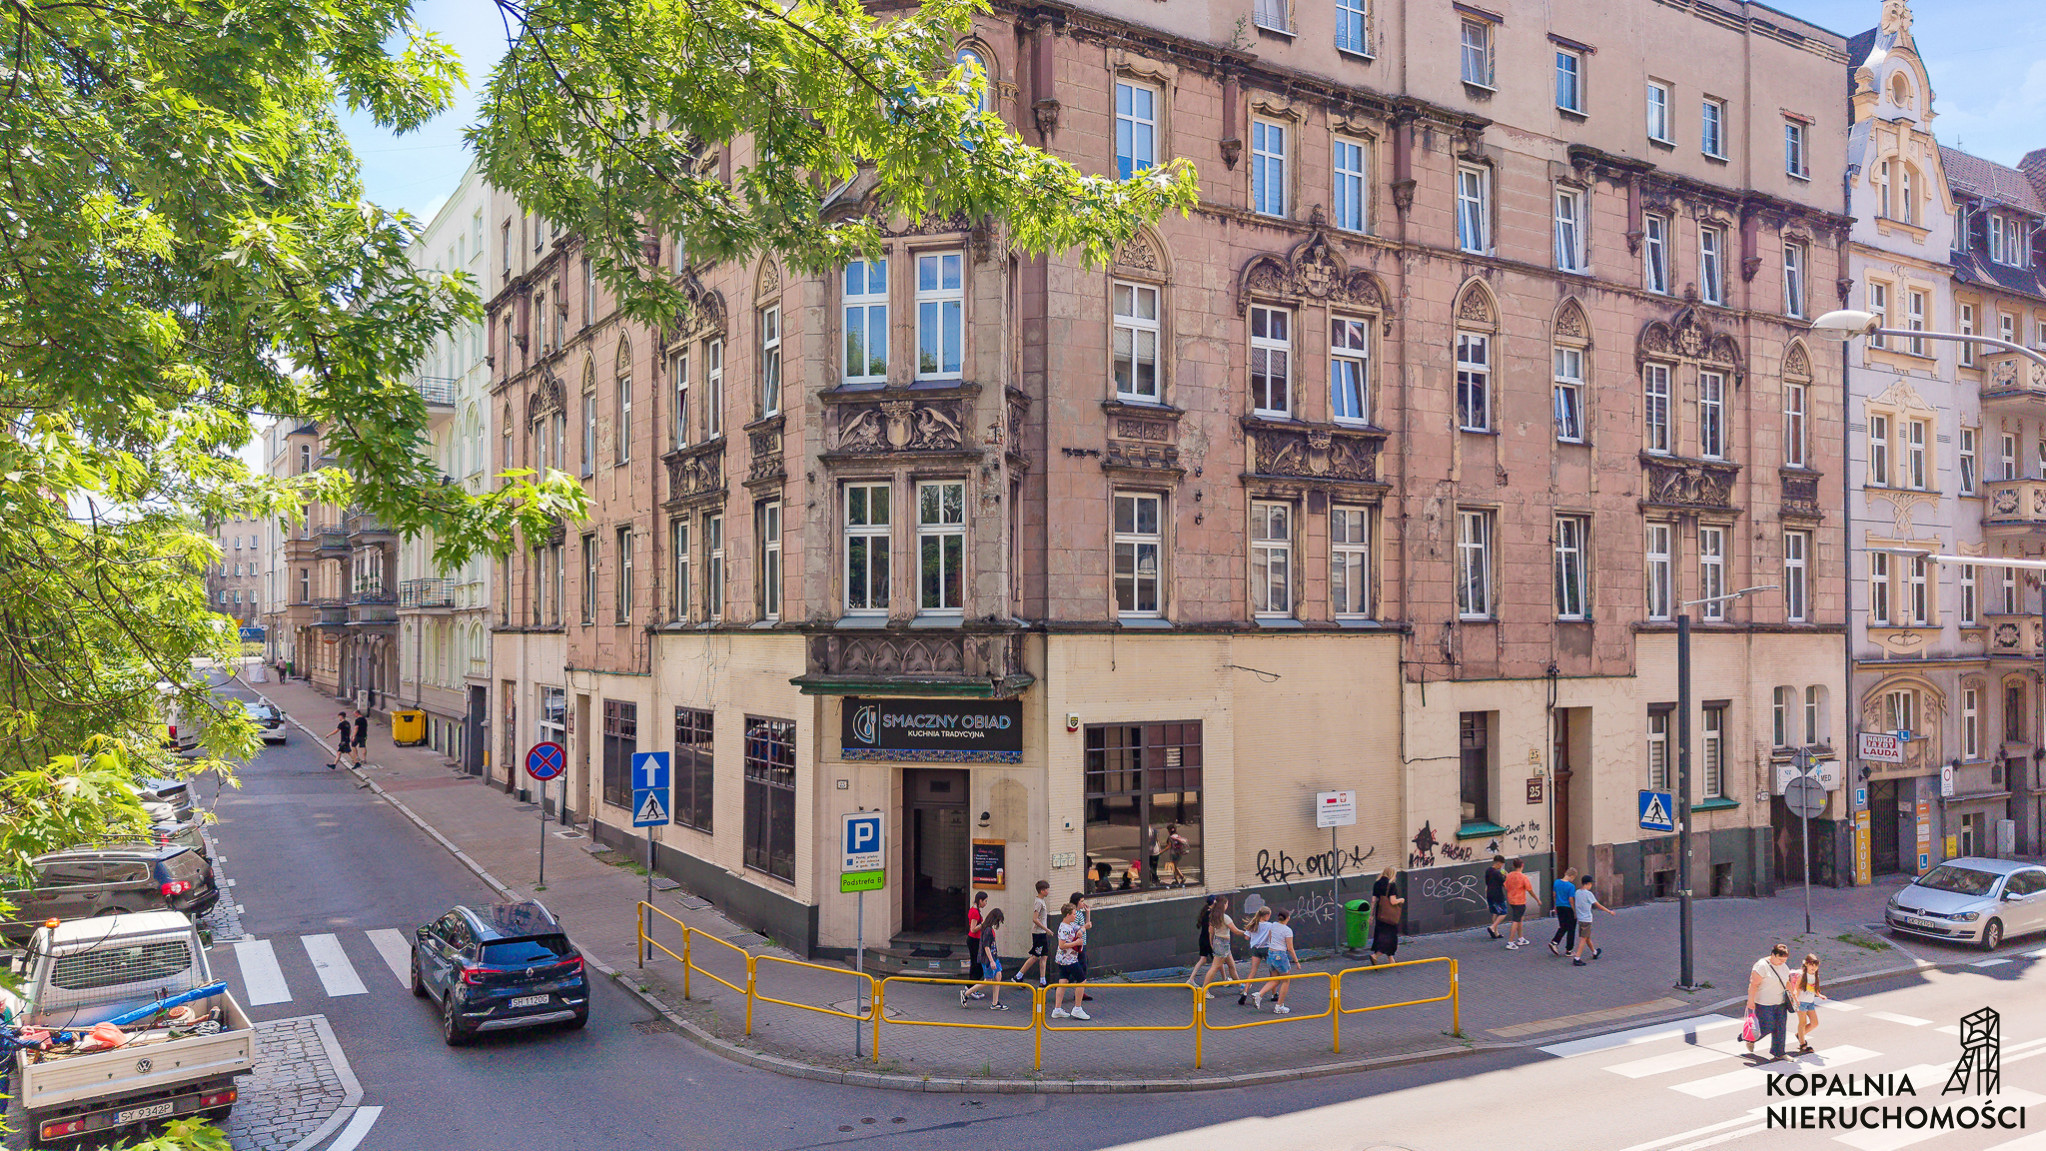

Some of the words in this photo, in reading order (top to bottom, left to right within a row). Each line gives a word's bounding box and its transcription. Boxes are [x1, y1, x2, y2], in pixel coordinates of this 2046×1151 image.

[882, 713, 958, 728] SMACZNY
[961, 714, 1012, 729] OBIAD
[907, 730, 940, 738] KUCHNIA
[941, 730, 985, 739] TRADYCYJNA
[1863, 748, 1898, 757] LAUDA
[1529, 785, 1540, 798] 25
[854, 822, 874, 850] P
[843, 877, 875, 887] Podstrefa
[138, 1103, 171, 1118] 9342P
